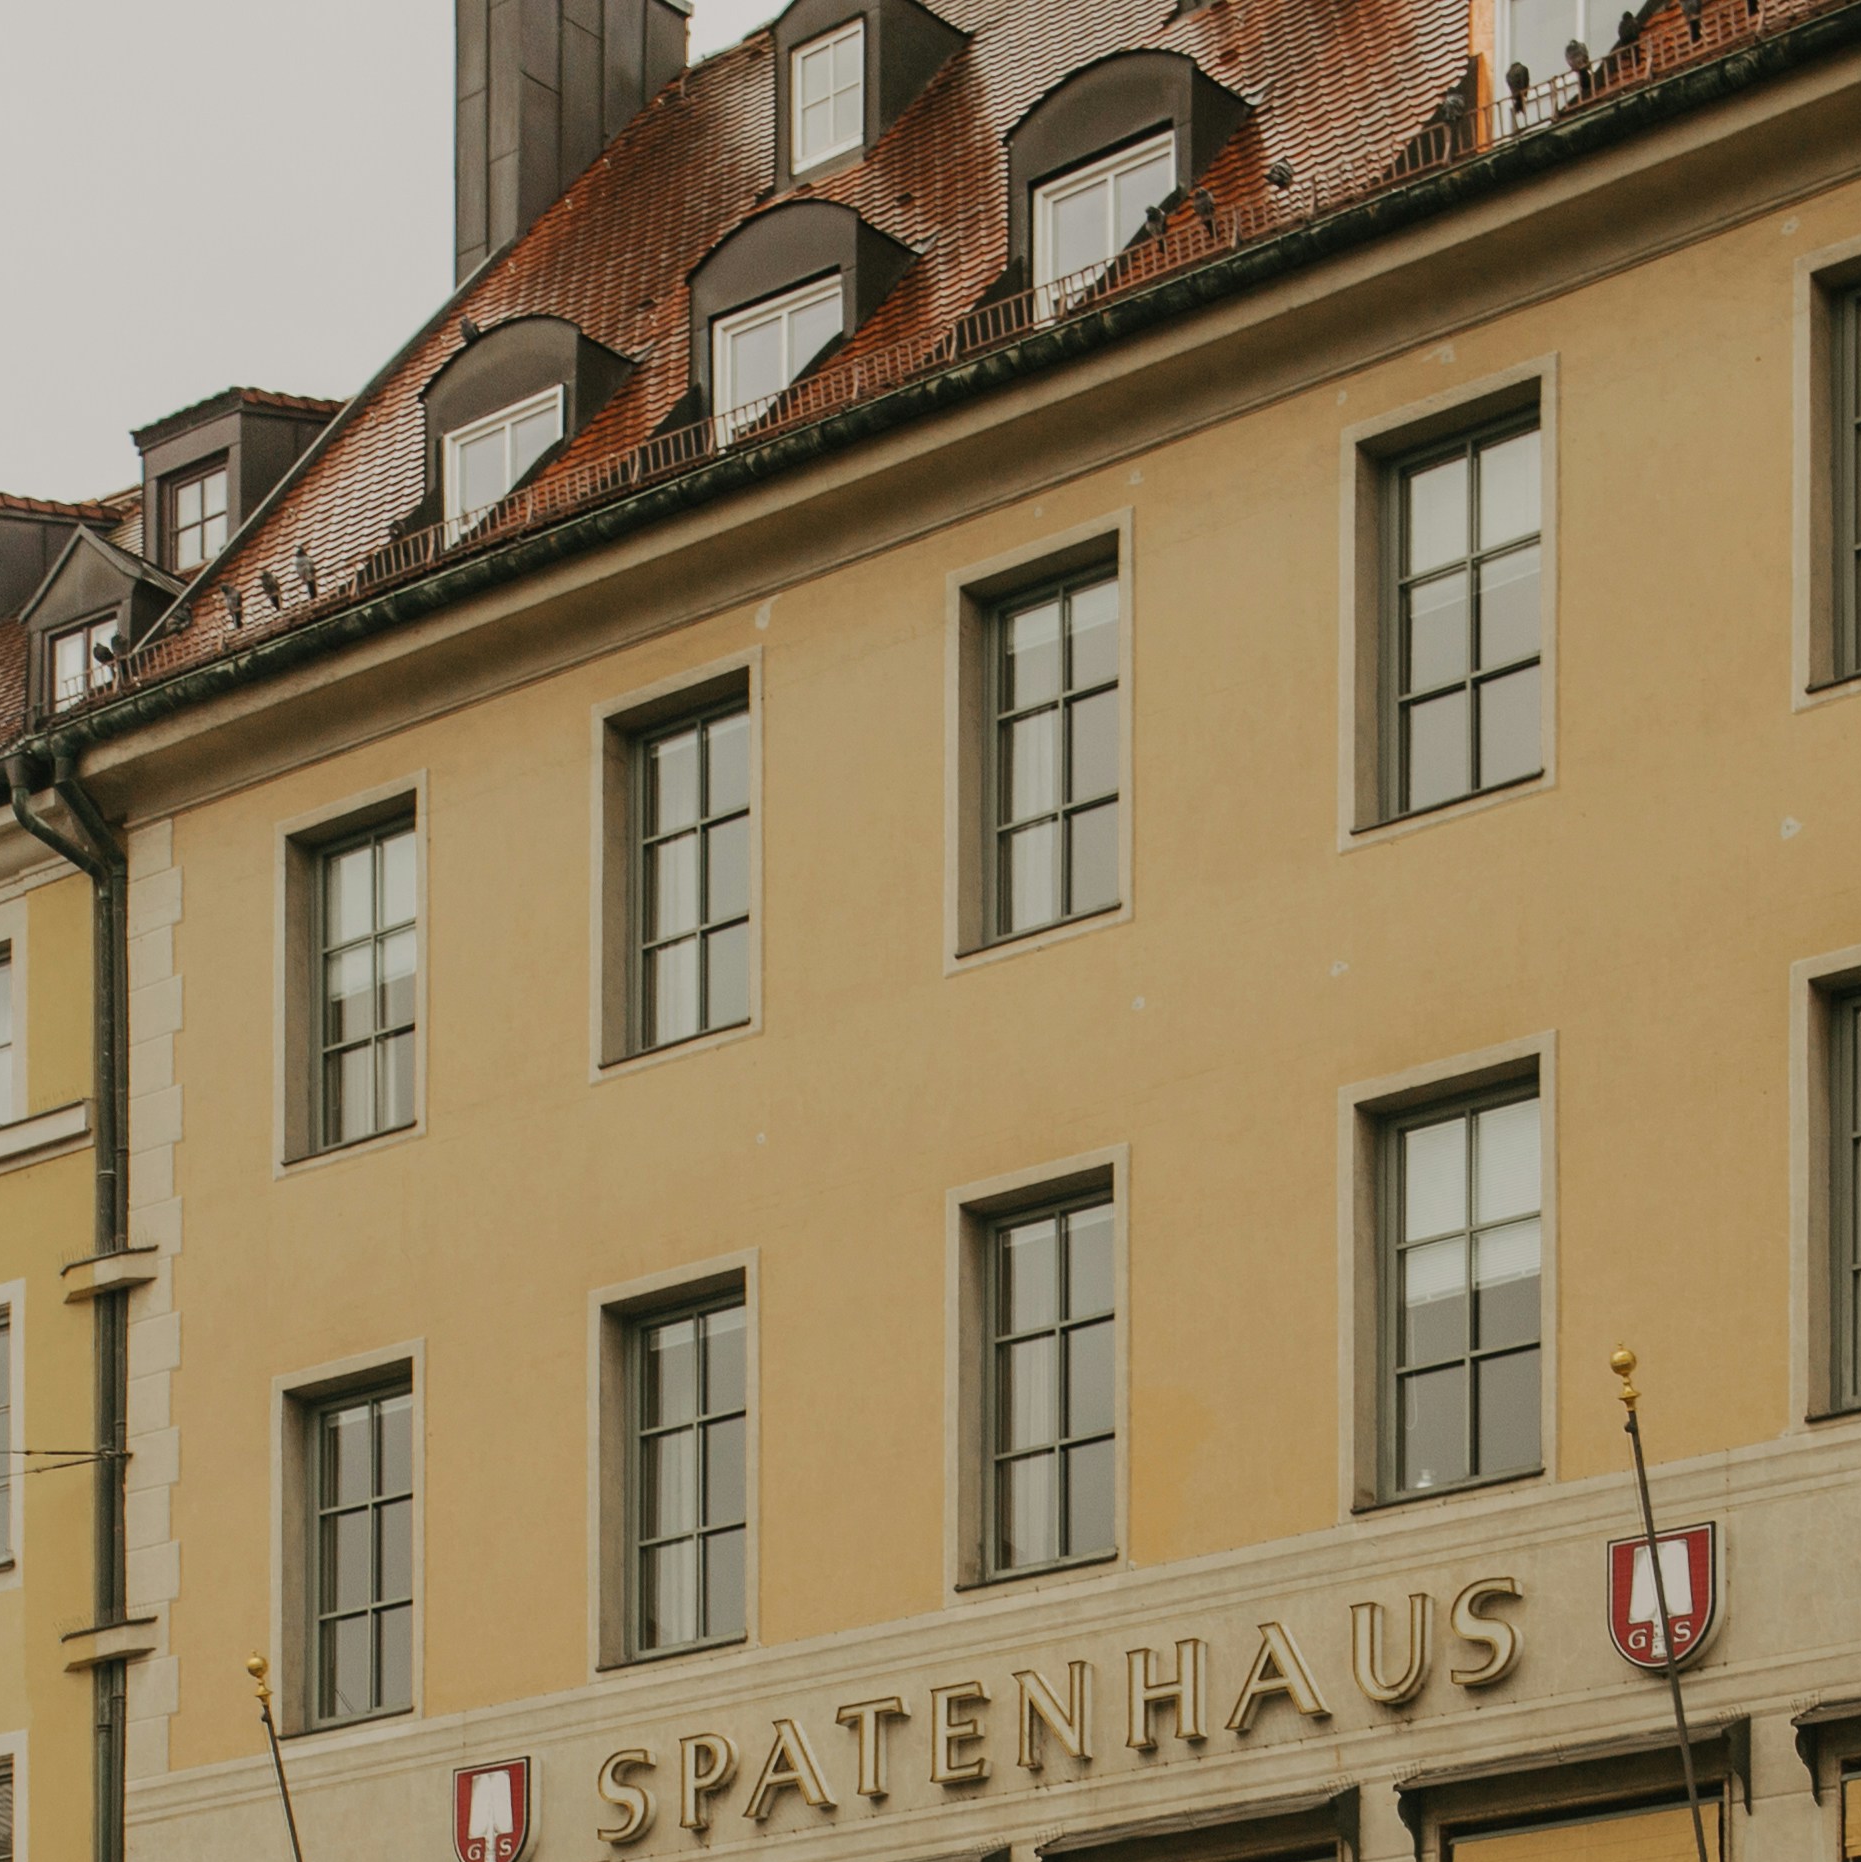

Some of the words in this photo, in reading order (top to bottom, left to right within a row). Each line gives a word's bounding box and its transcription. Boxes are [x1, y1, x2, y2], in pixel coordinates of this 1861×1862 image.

[1628, 1628, 1648, 1650] G
[1673, 1620, 1691, 1643] S
[596, 1576, 1524, 1844] SPATENHAUS
[467, 1843, 482, 1860] G
[498, 1838, 512, 1857] S
